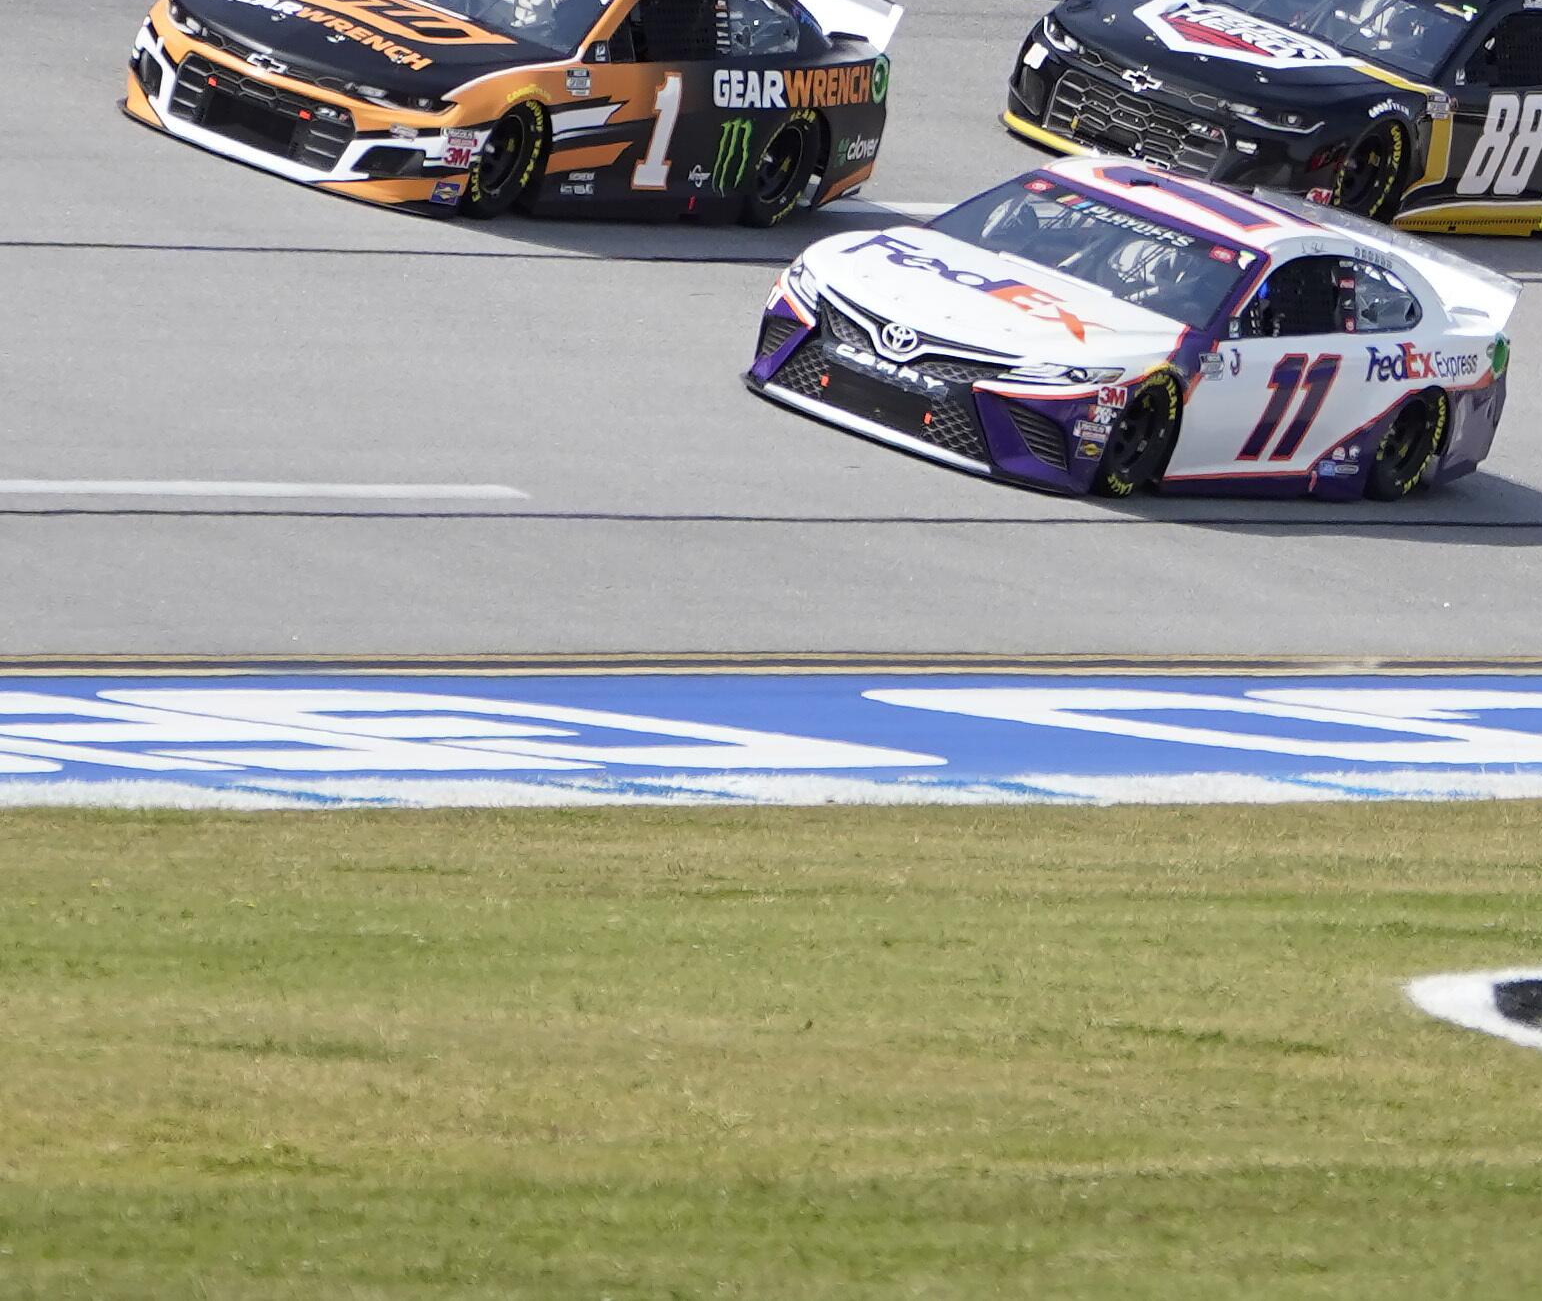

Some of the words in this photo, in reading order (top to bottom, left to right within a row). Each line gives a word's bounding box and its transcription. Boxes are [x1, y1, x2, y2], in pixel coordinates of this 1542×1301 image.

[713, 65, 871, 109] GEARWRENCH
[631, 71, 683, 191] 1
[846, 137, 878, 162] clover
[444, 146, 472, 168] 3M
[1085, 205, 1196, 248] PLAYOFFS
[841, 234, 1115, 345] FedEx
[835, 344, 947, 390] CAMRY
[1365, 342, 1439, 382] FedEx
[1435, 350, 1478, 383] Express
[1100, 386, 1126, 407] 3M
[1237, 352, 1343, 461] 11
